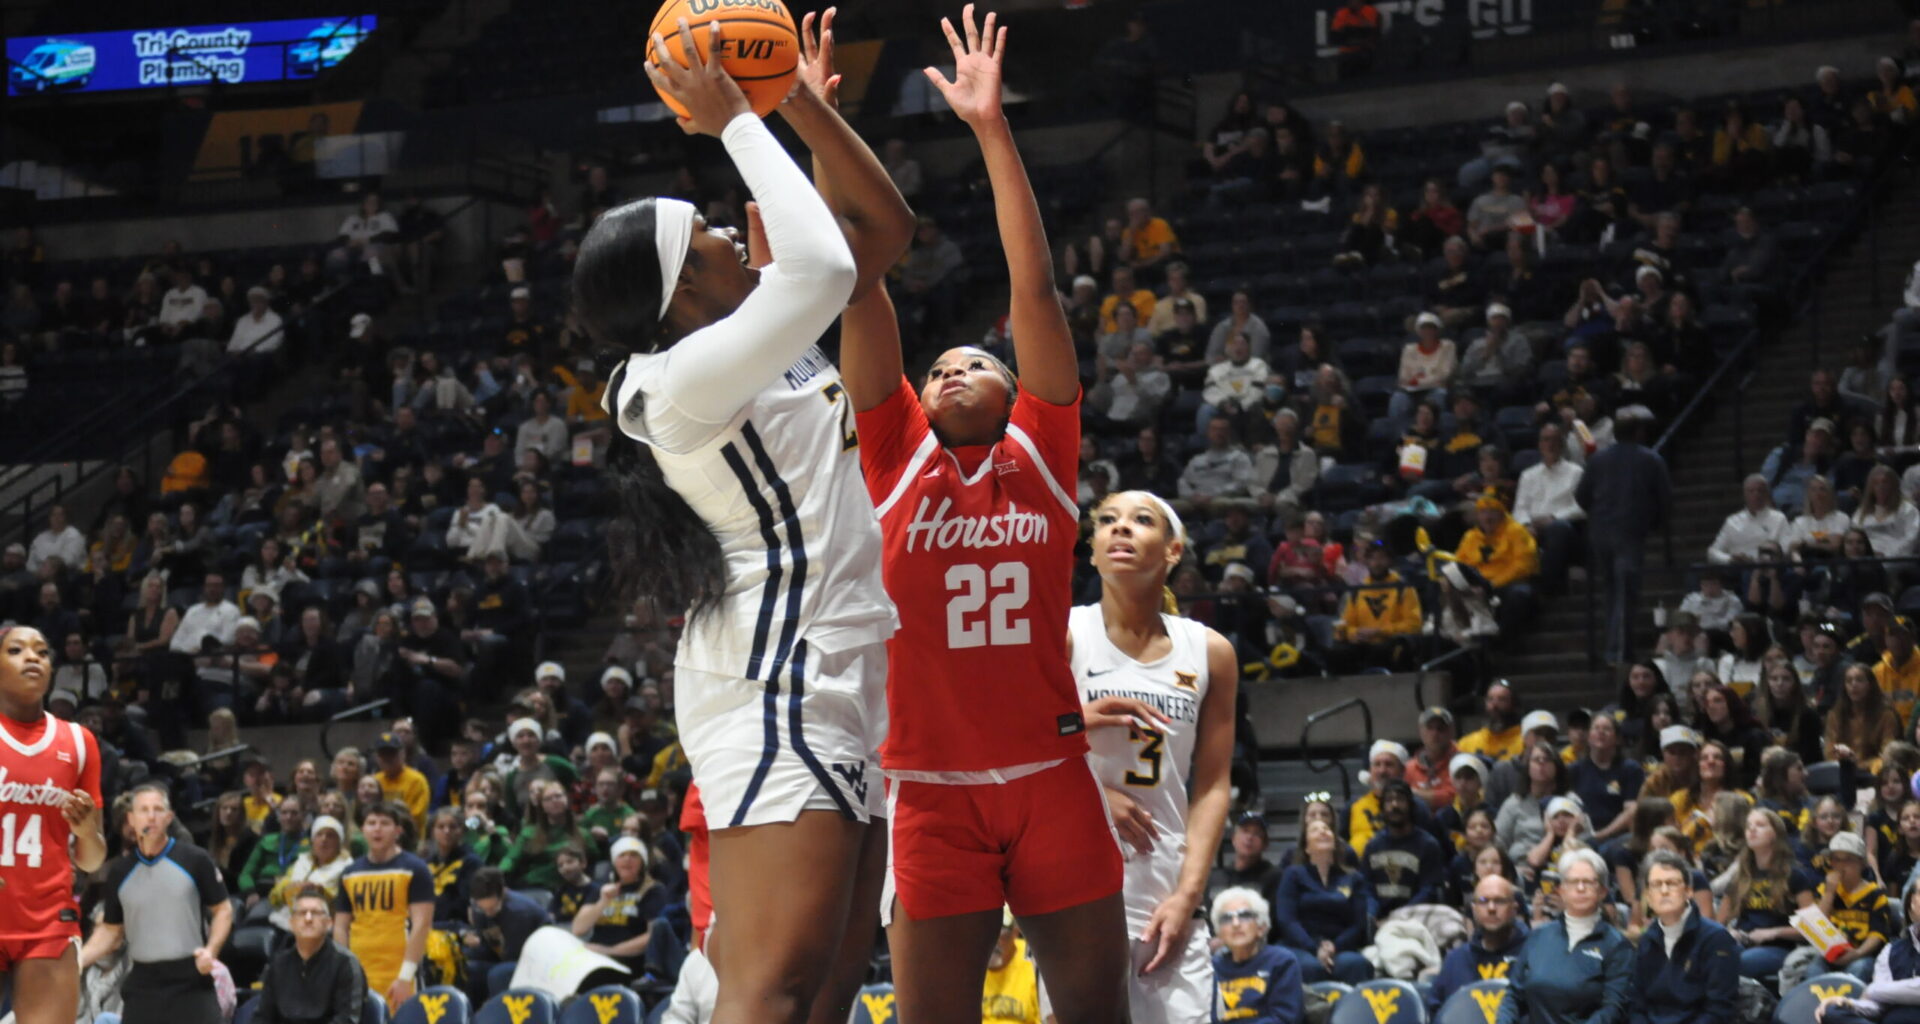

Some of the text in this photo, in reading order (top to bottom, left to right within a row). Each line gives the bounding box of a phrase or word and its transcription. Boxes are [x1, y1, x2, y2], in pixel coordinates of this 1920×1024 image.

[135, 30, 249, 55] Tri-County
[720, 39, 774, 60] EVO
[1315, 0, 1444, 58] LT'S
[141, 57, 243, 82] Plmbing
[906, 495, 1048, 553] Houston
[944, 561, 1031, 649] 22
[1125, 726, 1164, 787] 3
[0, 812, 42, 868] 14
[353, 880, 394, 911] WVU
